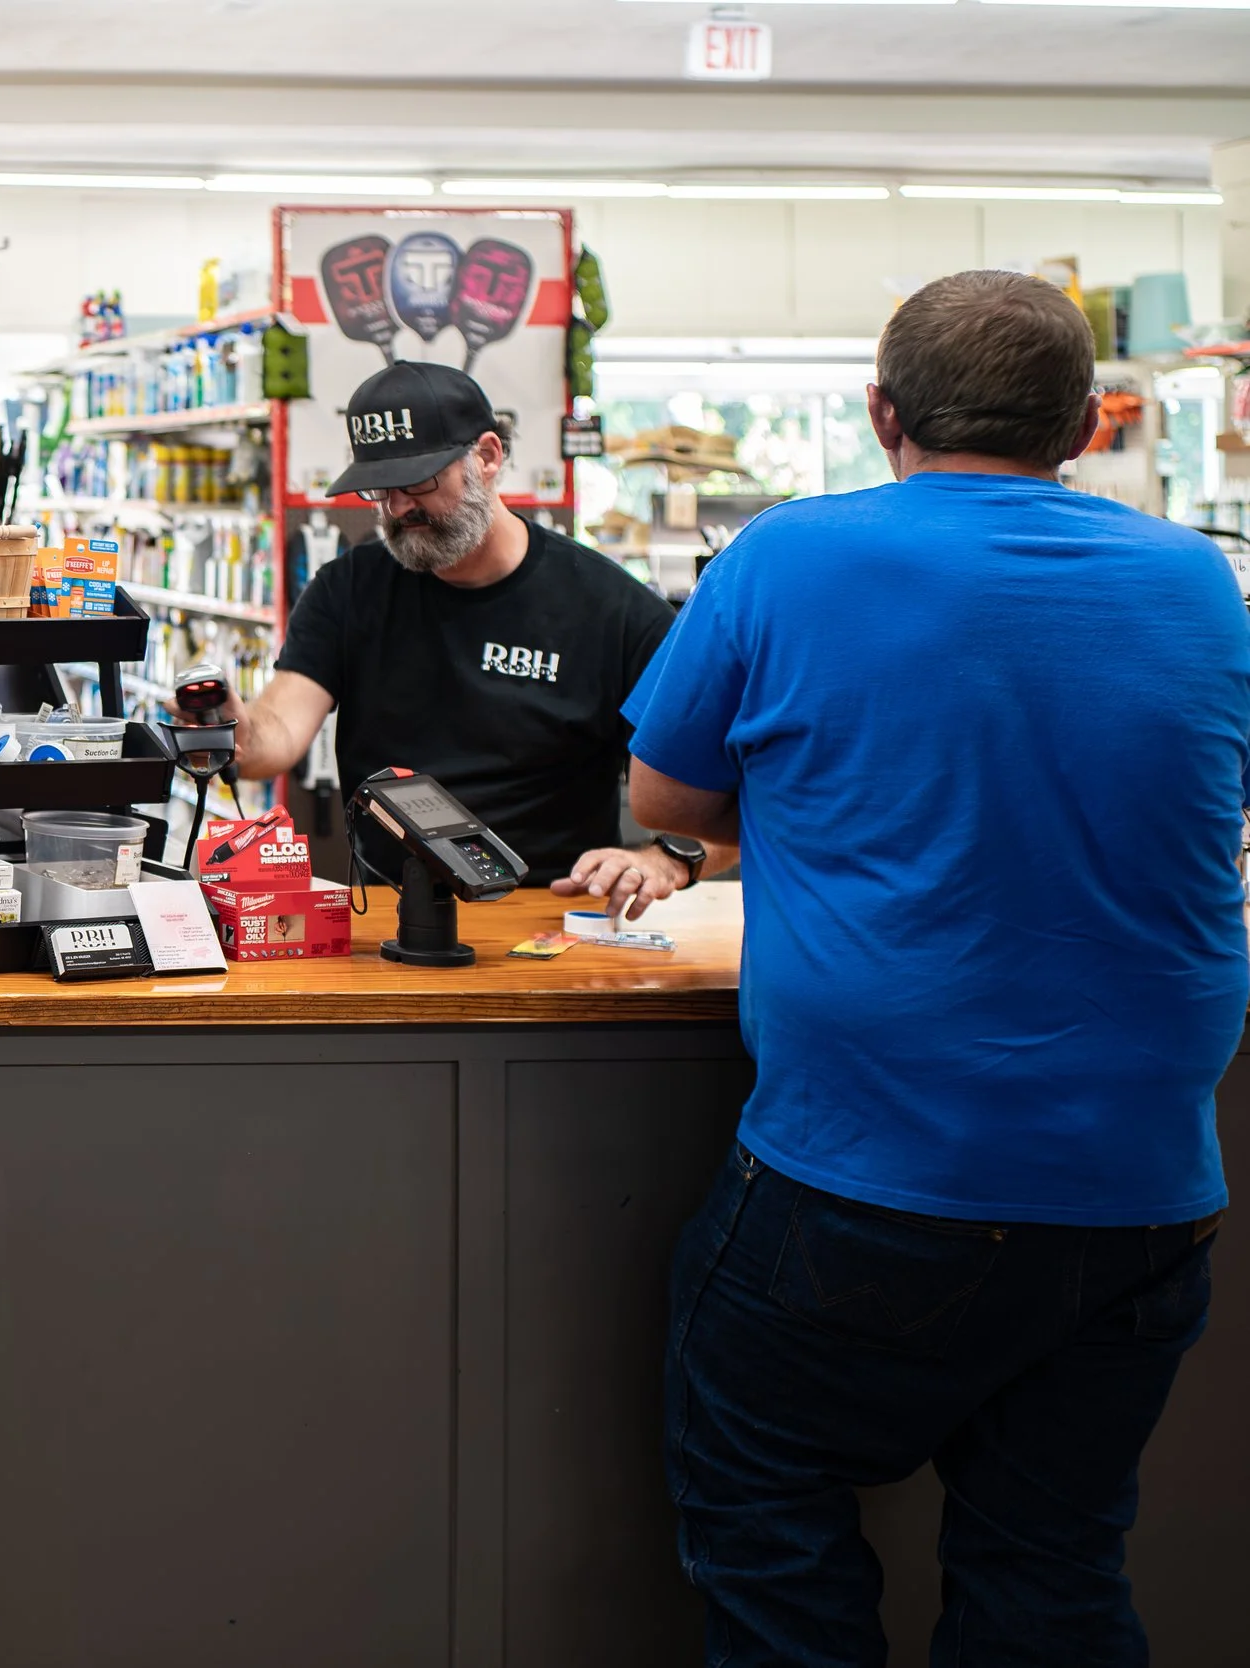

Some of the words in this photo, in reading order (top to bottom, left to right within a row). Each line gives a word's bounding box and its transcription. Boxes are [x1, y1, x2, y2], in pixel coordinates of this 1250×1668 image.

[705, 25, 763, 71] EXIT
[351, 409, 414, 446] RBH
[65, 561, 94, 570] O'KEEFFE'S
[481, 641, 561, 682] RBH
[84, 748, 109, 757] Suction
[110, 748, 119, 757] Cup
[259, 842, 308, 856] CLOG
[260, 855, 309, 865] RESISTANT
[240, 893, 275, 909] Milwaukee
[323, 893, 349, 901] INKZALL
[240, 920, 266, 928] DUST
[245, 926, 266, 934] WET
[245, 933, 266, 941] OILY
